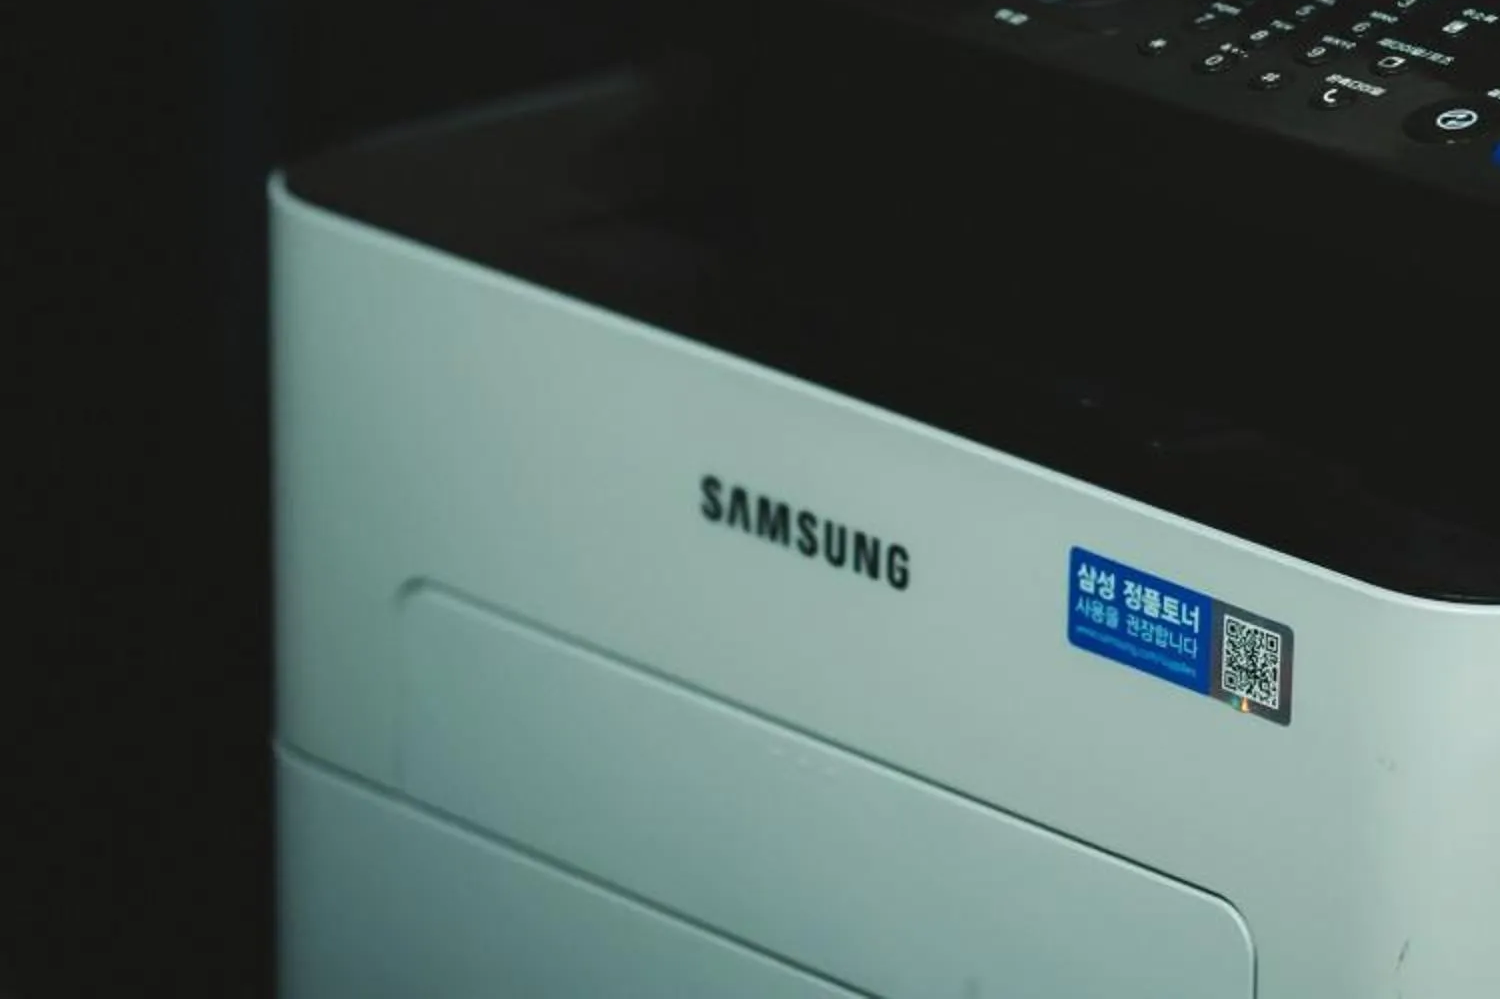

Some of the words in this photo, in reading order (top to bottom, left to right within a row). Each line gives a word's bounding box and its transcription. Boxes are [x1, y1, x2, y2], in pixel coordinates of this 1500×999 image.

[700, 474, 910, 592] SAMSUNG
[1074, 596, 1120, 630] 사용을
[1126, 613, 1199, 660] 권장합니다
[1077, 562, 1117, 600] 삼성
[1122, 579, 1200, 633] 정품토너
